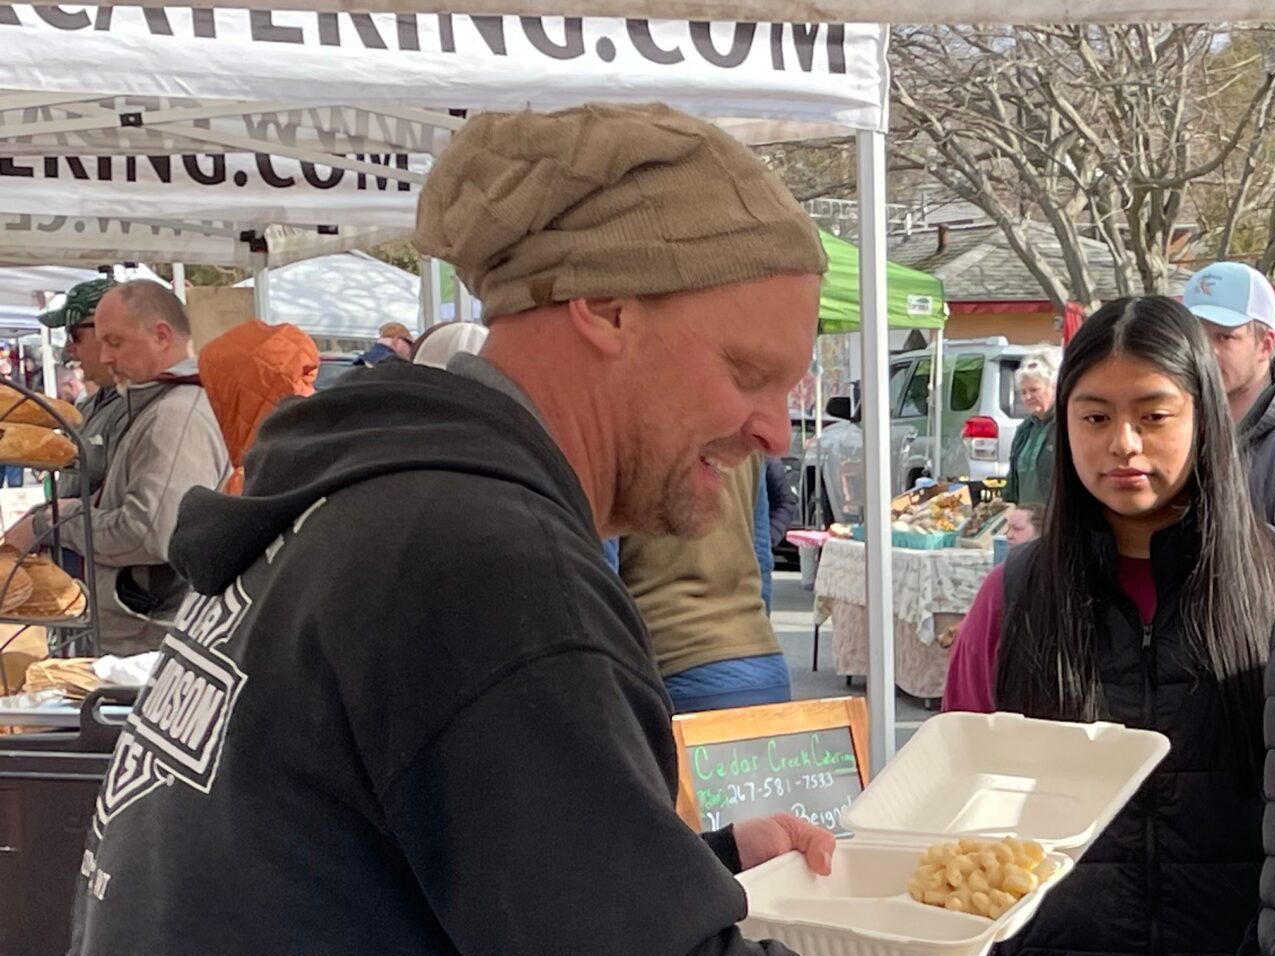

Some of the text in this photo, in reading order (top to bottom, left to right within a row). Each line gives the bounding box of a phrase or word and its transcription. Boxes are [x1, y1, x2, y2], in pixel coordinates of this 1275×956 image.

[694, 746, 760, 780] Cedar
[767, 740, 812, 772] Creek
[727, 772, 834, 804] 267-581-7533
